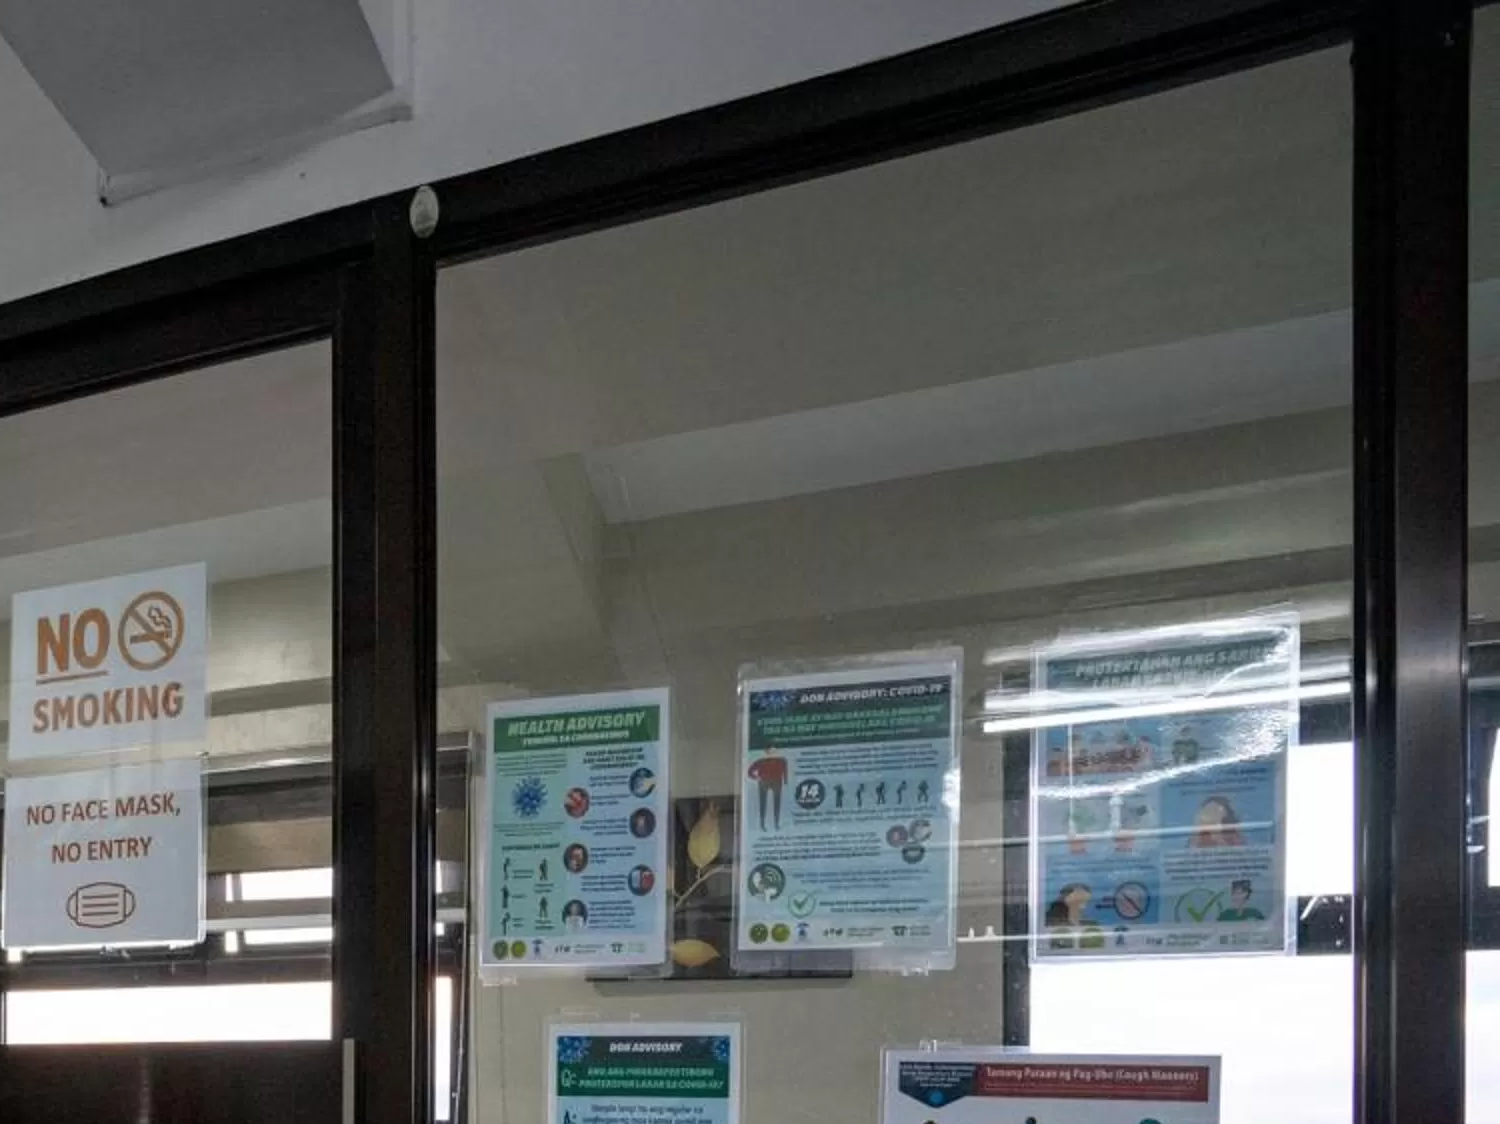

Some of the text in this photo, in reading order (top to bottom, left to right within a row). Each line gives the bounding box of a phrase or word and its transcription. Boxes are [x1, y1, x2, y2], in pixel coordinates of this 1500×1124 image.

[37, 607, 111, 675] NO
[33, 682, 184, 733] SMOKING
[508, 718, 565, 737] HEALTH
[566, 711, 646, 731] ADVISORY
[26, 792, 181, 826] NO FACE MASK,
[52, 837, 152, 864] NO ENTRY
